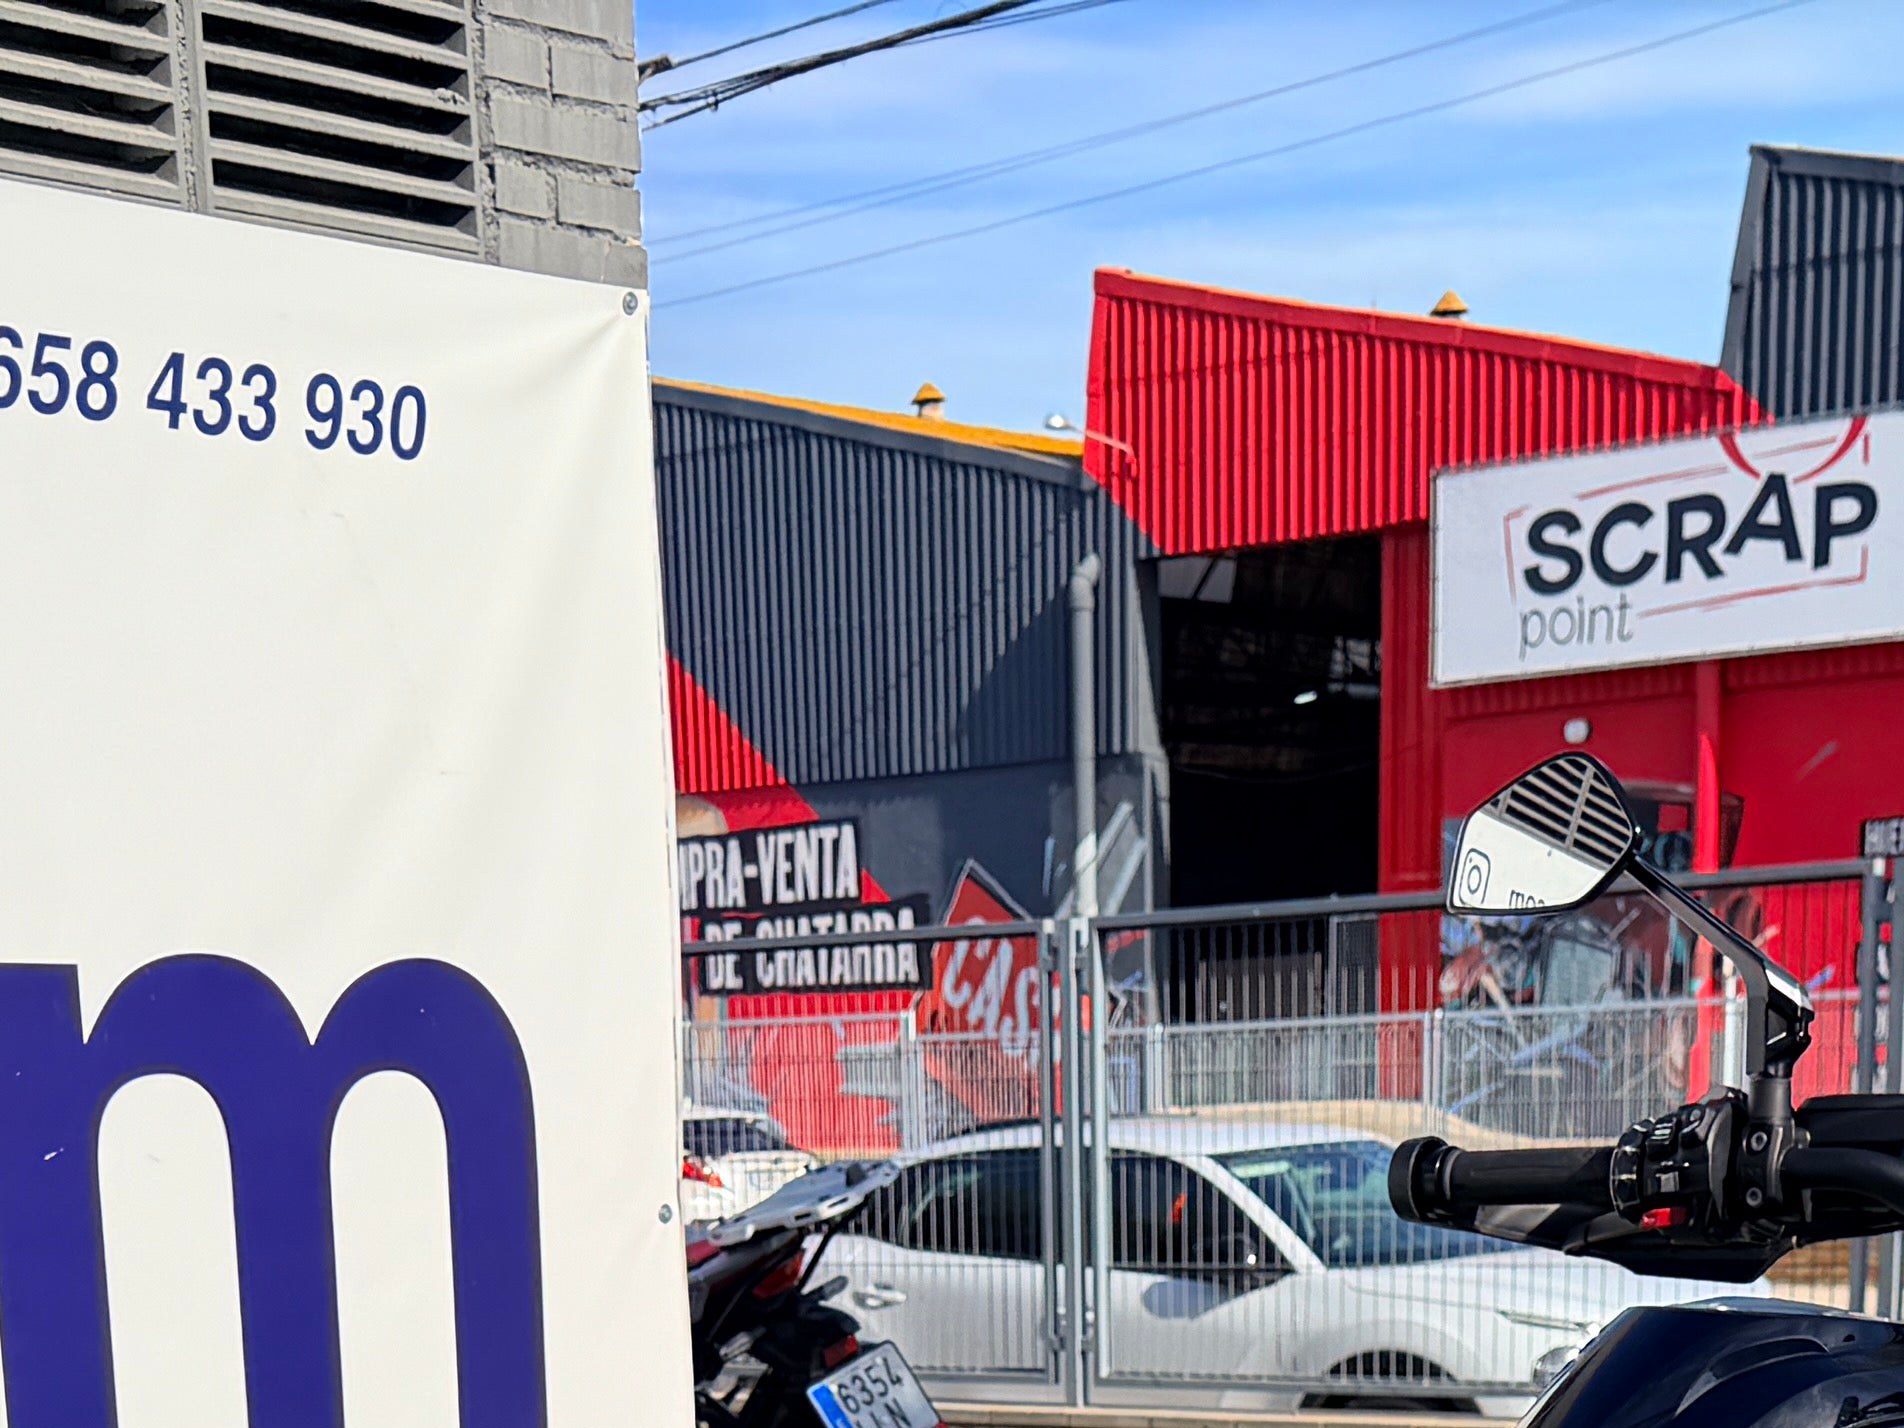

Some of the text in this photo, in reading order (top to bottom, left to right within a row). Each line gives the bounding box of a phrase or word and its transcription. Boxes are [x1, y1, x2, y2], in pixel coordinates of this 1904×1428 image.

[147, 349, 278, 442] 433
[302, 371, 428, 461] 930
[1523, 472, 1879, 596] SCRAP
[1519, 592, 1635, 662] point
[704, 920, 744, 991] DE
[837, 1356, 904, 1415] 6354
